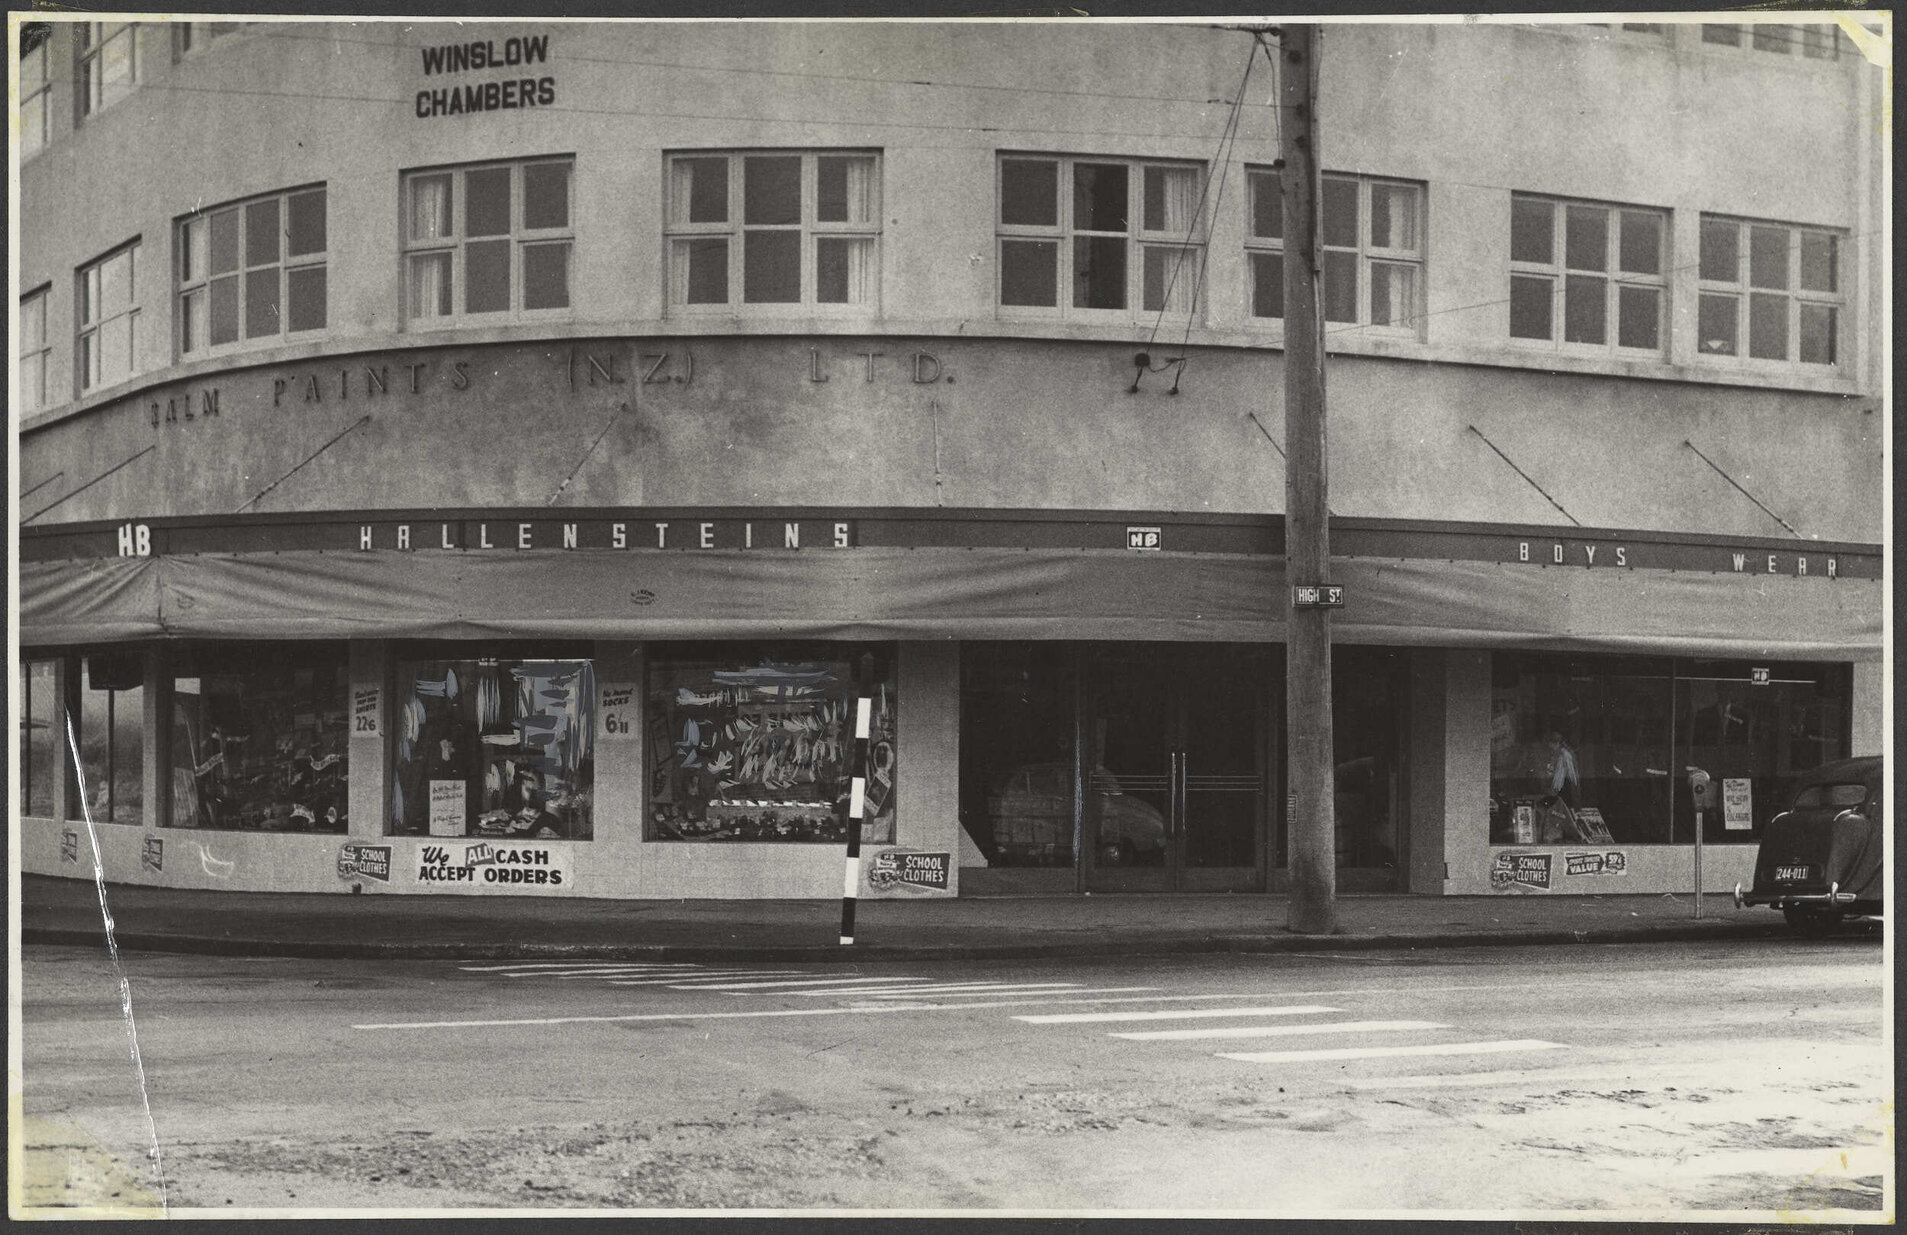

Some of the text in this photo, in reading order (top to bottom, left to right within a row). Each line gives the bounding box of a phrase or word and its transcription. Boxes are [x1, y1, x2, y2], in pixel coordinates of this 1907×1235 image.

[422, 34, 549, 76] WINSLOW
[415, 76, 555, 118] CHAMBERS
[273, 361, 470, 408] PAINTS
[810, 348, 956, 385] LTD.
[117, 523, 151, 557] HB
[360, 522, 849, 550] HALLENSTEINS
[1131, 532, 1158, 547] HB
[1520, 542, 1837, 577] BOYS WEAR
[1298, 588, 1320, 602] HIGH
[361, 848, 386, 862] SCHOOL
[422, 845, 549, 866] We ALL CASH
[905, 855, 943, 870] SCHOOL
[360, 860, 387, 874] CLOTHES
[1519, 857, 1547, 870] SCHOOL
[1569, 862, 1599, 874] VALUE
[419, 866, 562, 884] ACCEPT ORDERS
[903, 868, 944, 882] CLOTHES
[1516, 870, 1547, 882] CLOTHES
